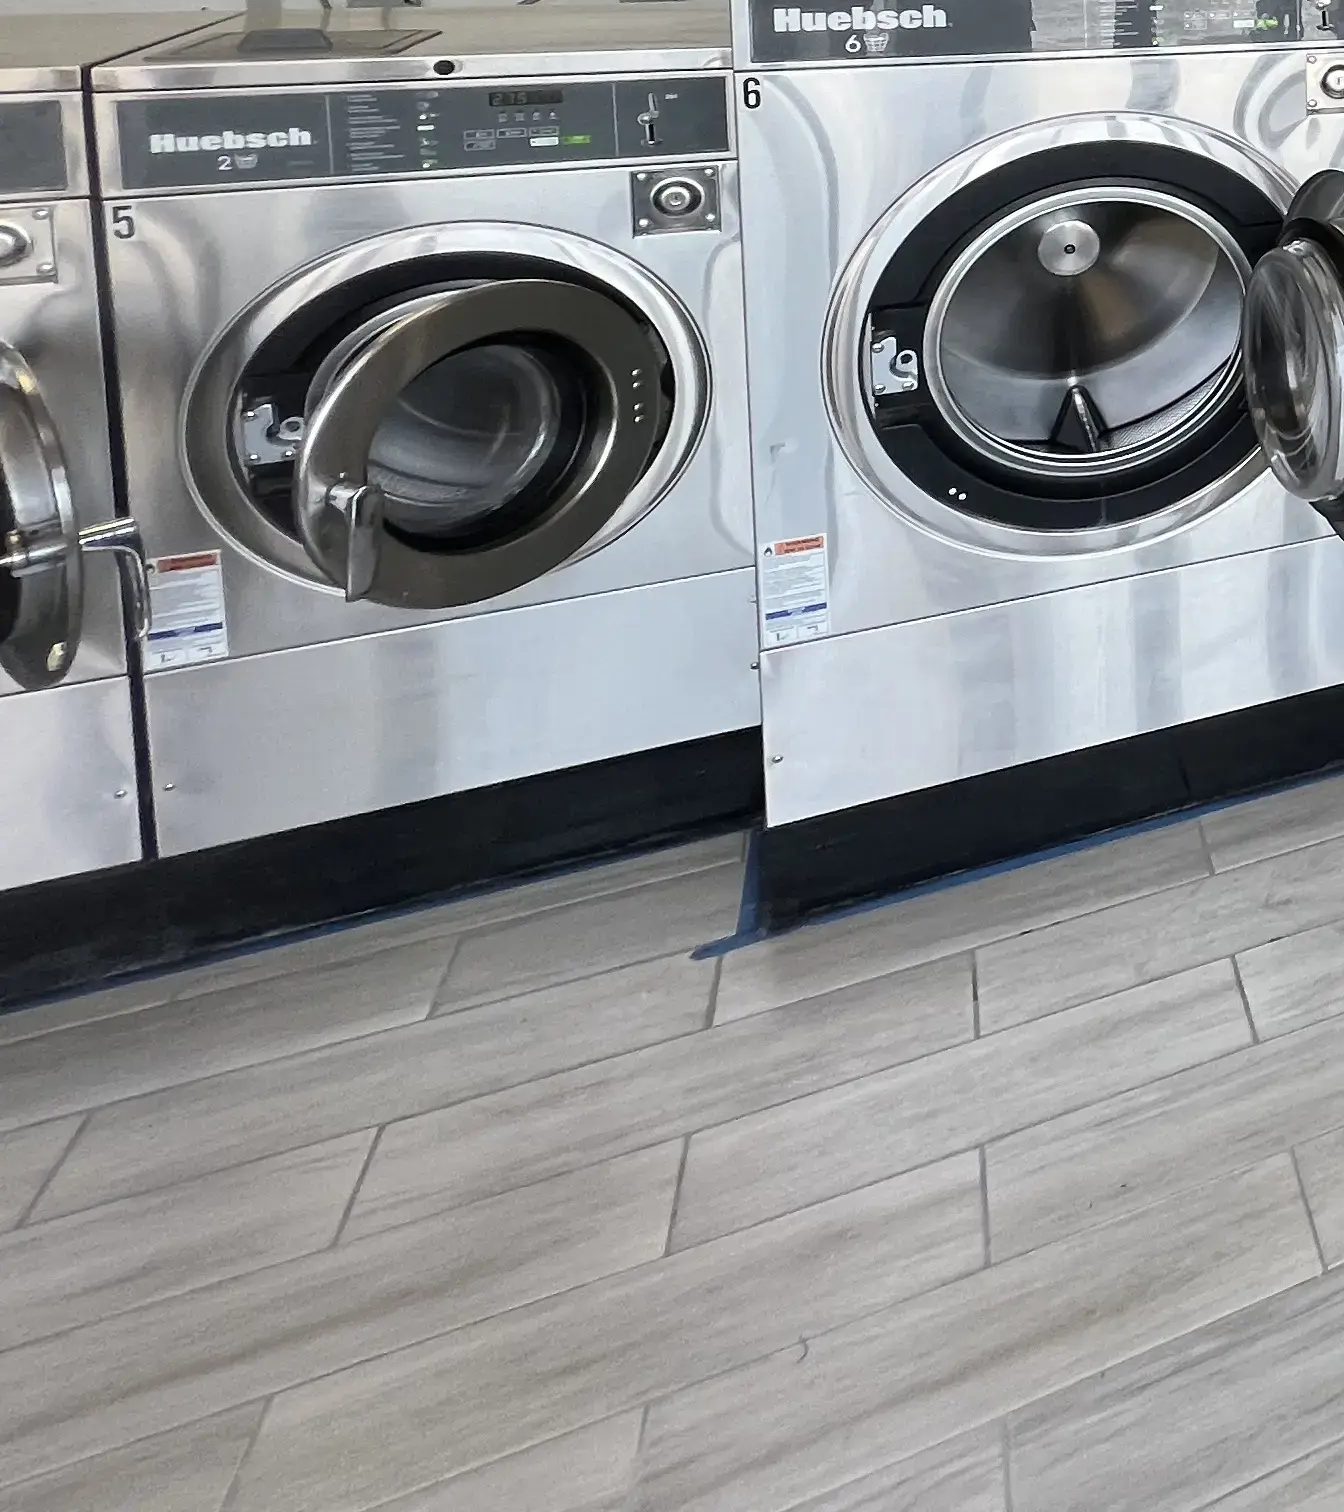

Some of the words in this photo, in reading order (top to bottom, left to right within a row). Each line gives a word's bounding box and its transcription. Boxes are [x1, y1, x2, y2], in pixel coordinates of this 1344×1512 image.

[773, 4, 948, 32] Huebsch
[845, 34, 862, 53] 6
[742, 77, 761, 109] 6
[150, 127, 312, 154] Huebsch
[217, 155, 233, 171] 2
[112, 205, 135, 239] 5
